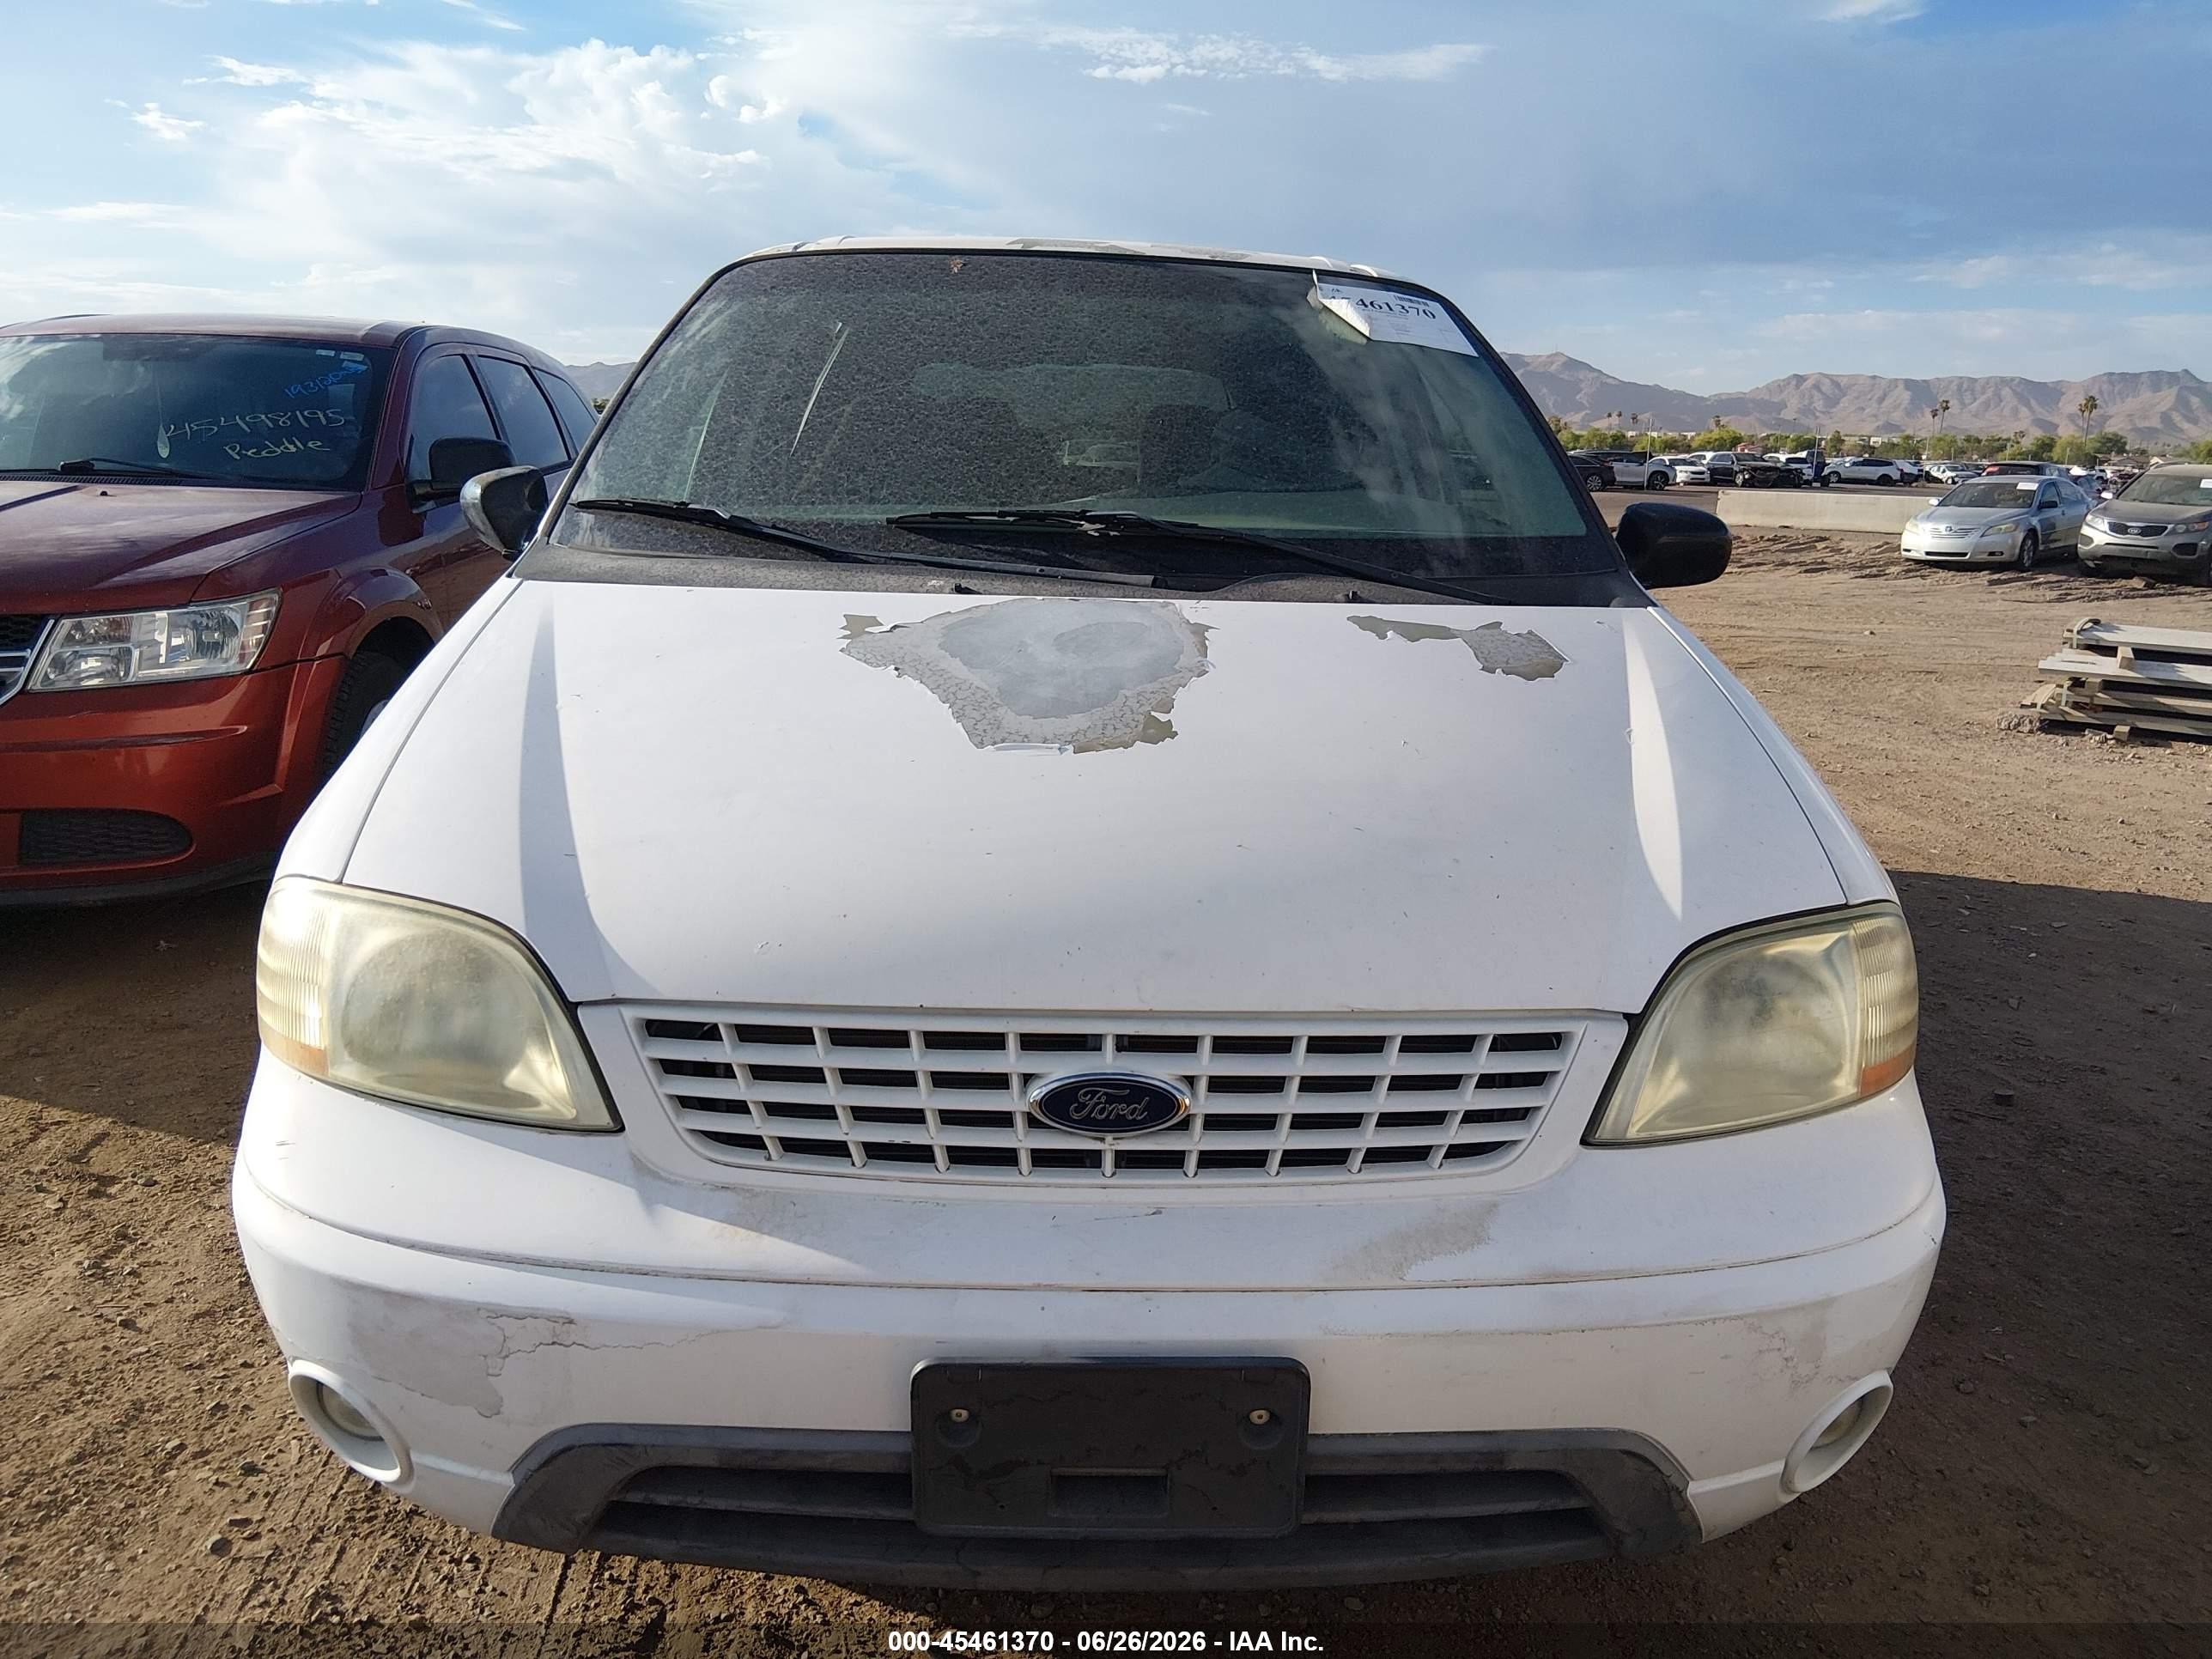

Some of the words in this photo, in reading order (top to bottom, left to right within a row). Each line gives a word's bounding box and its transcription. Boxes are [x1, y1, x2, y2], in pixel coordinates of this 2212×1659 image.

[1329, 295, 1437, 320] 461370
[167, 409, 345, 441] 45498195
[223, 435, 331, 460] Peddle
[1069, 1086, 1150, 1121] Ford
